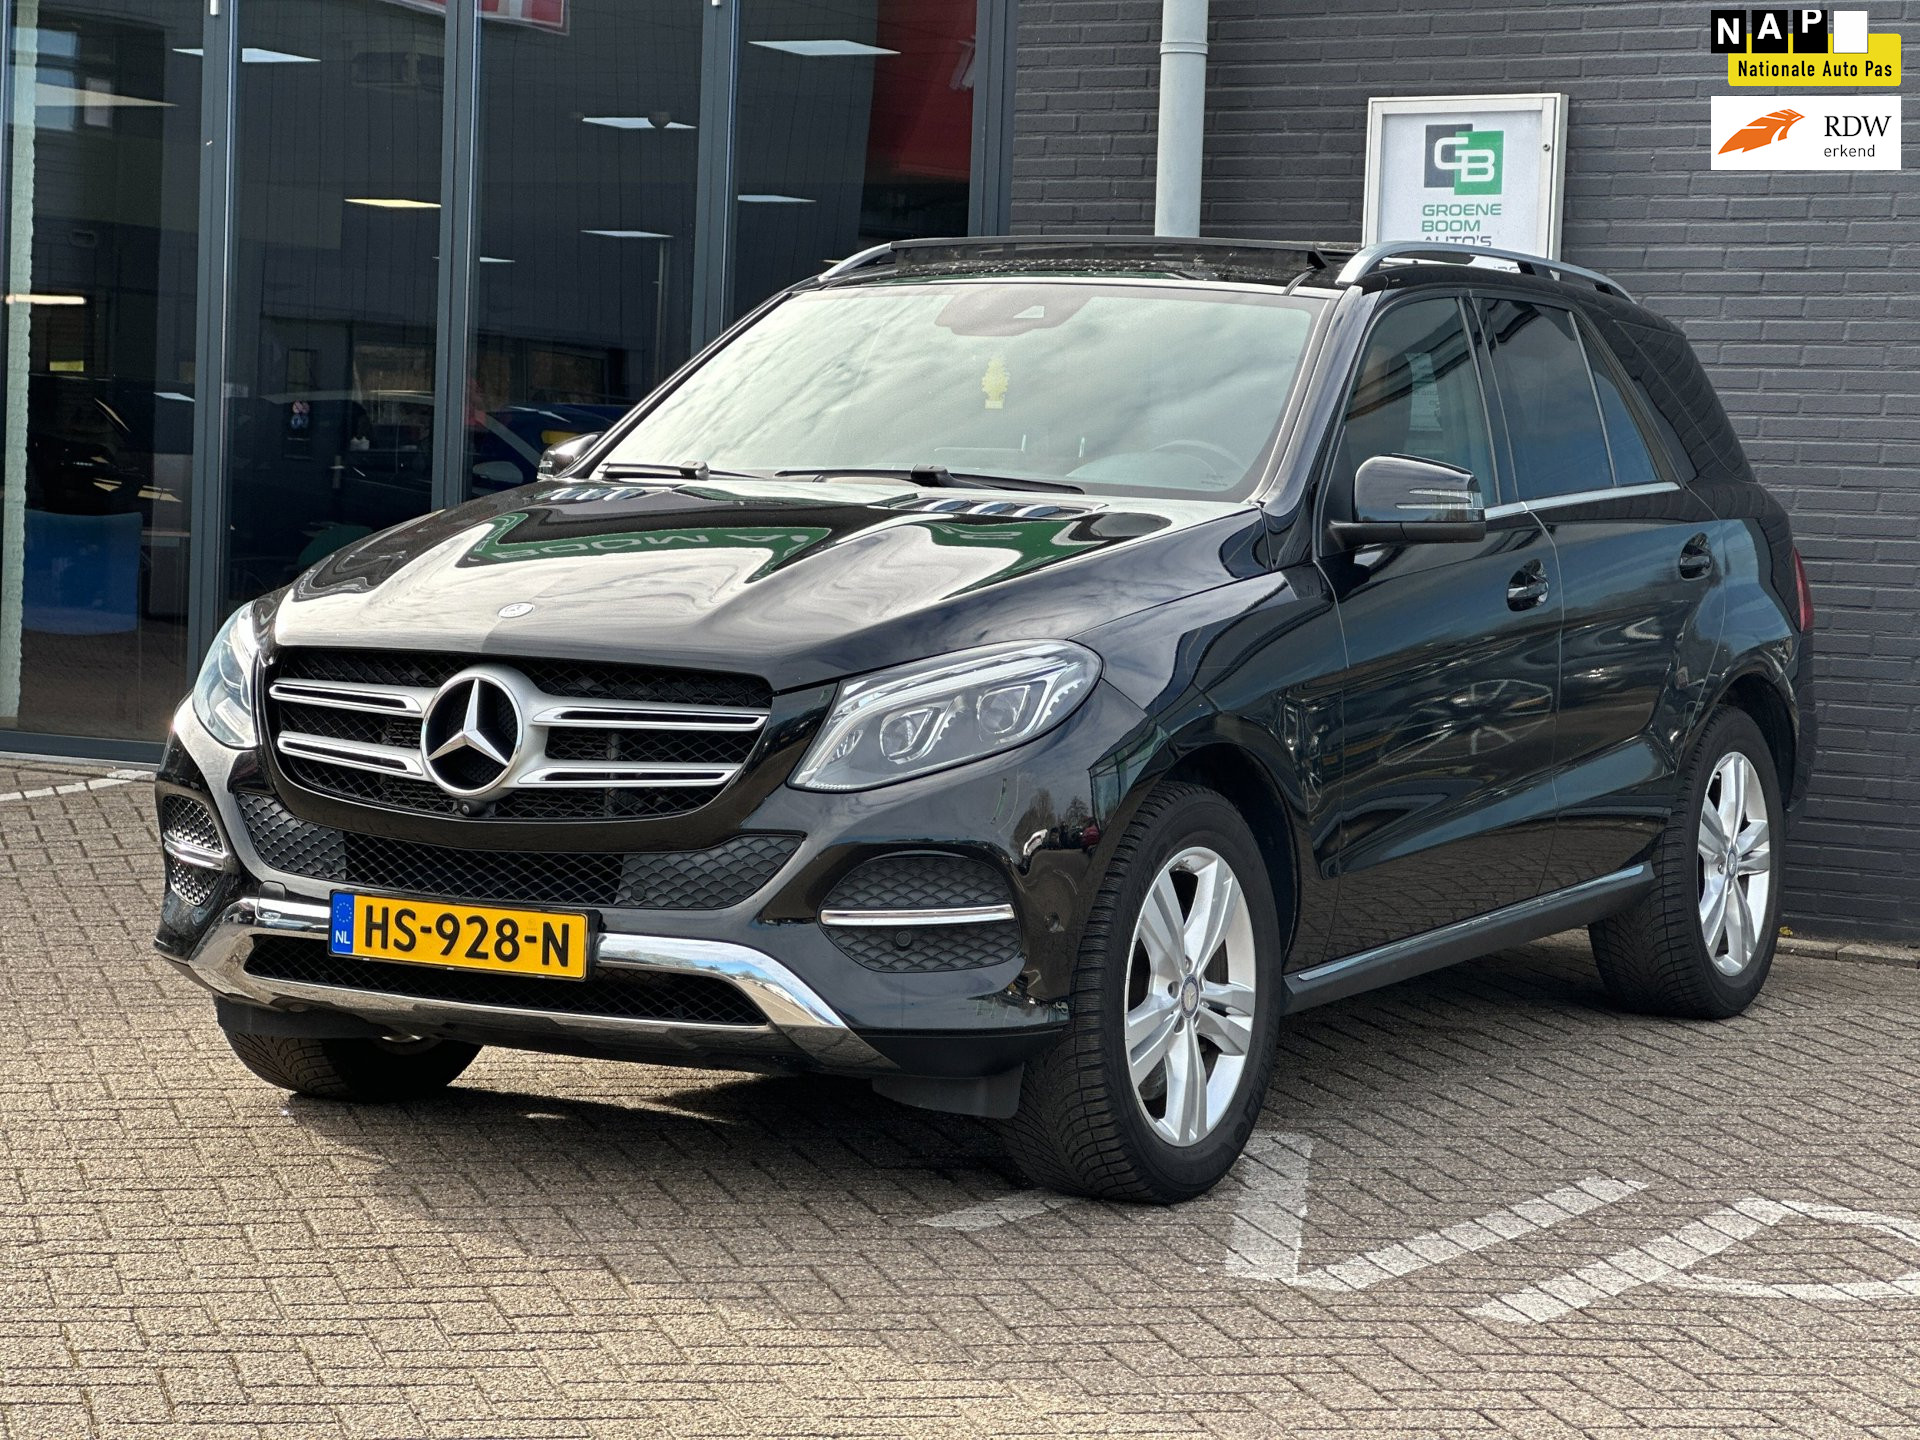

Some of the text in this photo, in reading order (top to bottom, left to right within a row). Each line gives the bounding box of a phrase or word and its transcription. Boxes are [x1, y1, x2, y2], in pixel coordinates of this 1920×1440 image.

[1422, 203, 1502, 217] GROENE
[1421, 219, 1481, 233] BOOM
[334, 930, 351, 945] NL
[364, 904, 570, 967] HS-928-N
